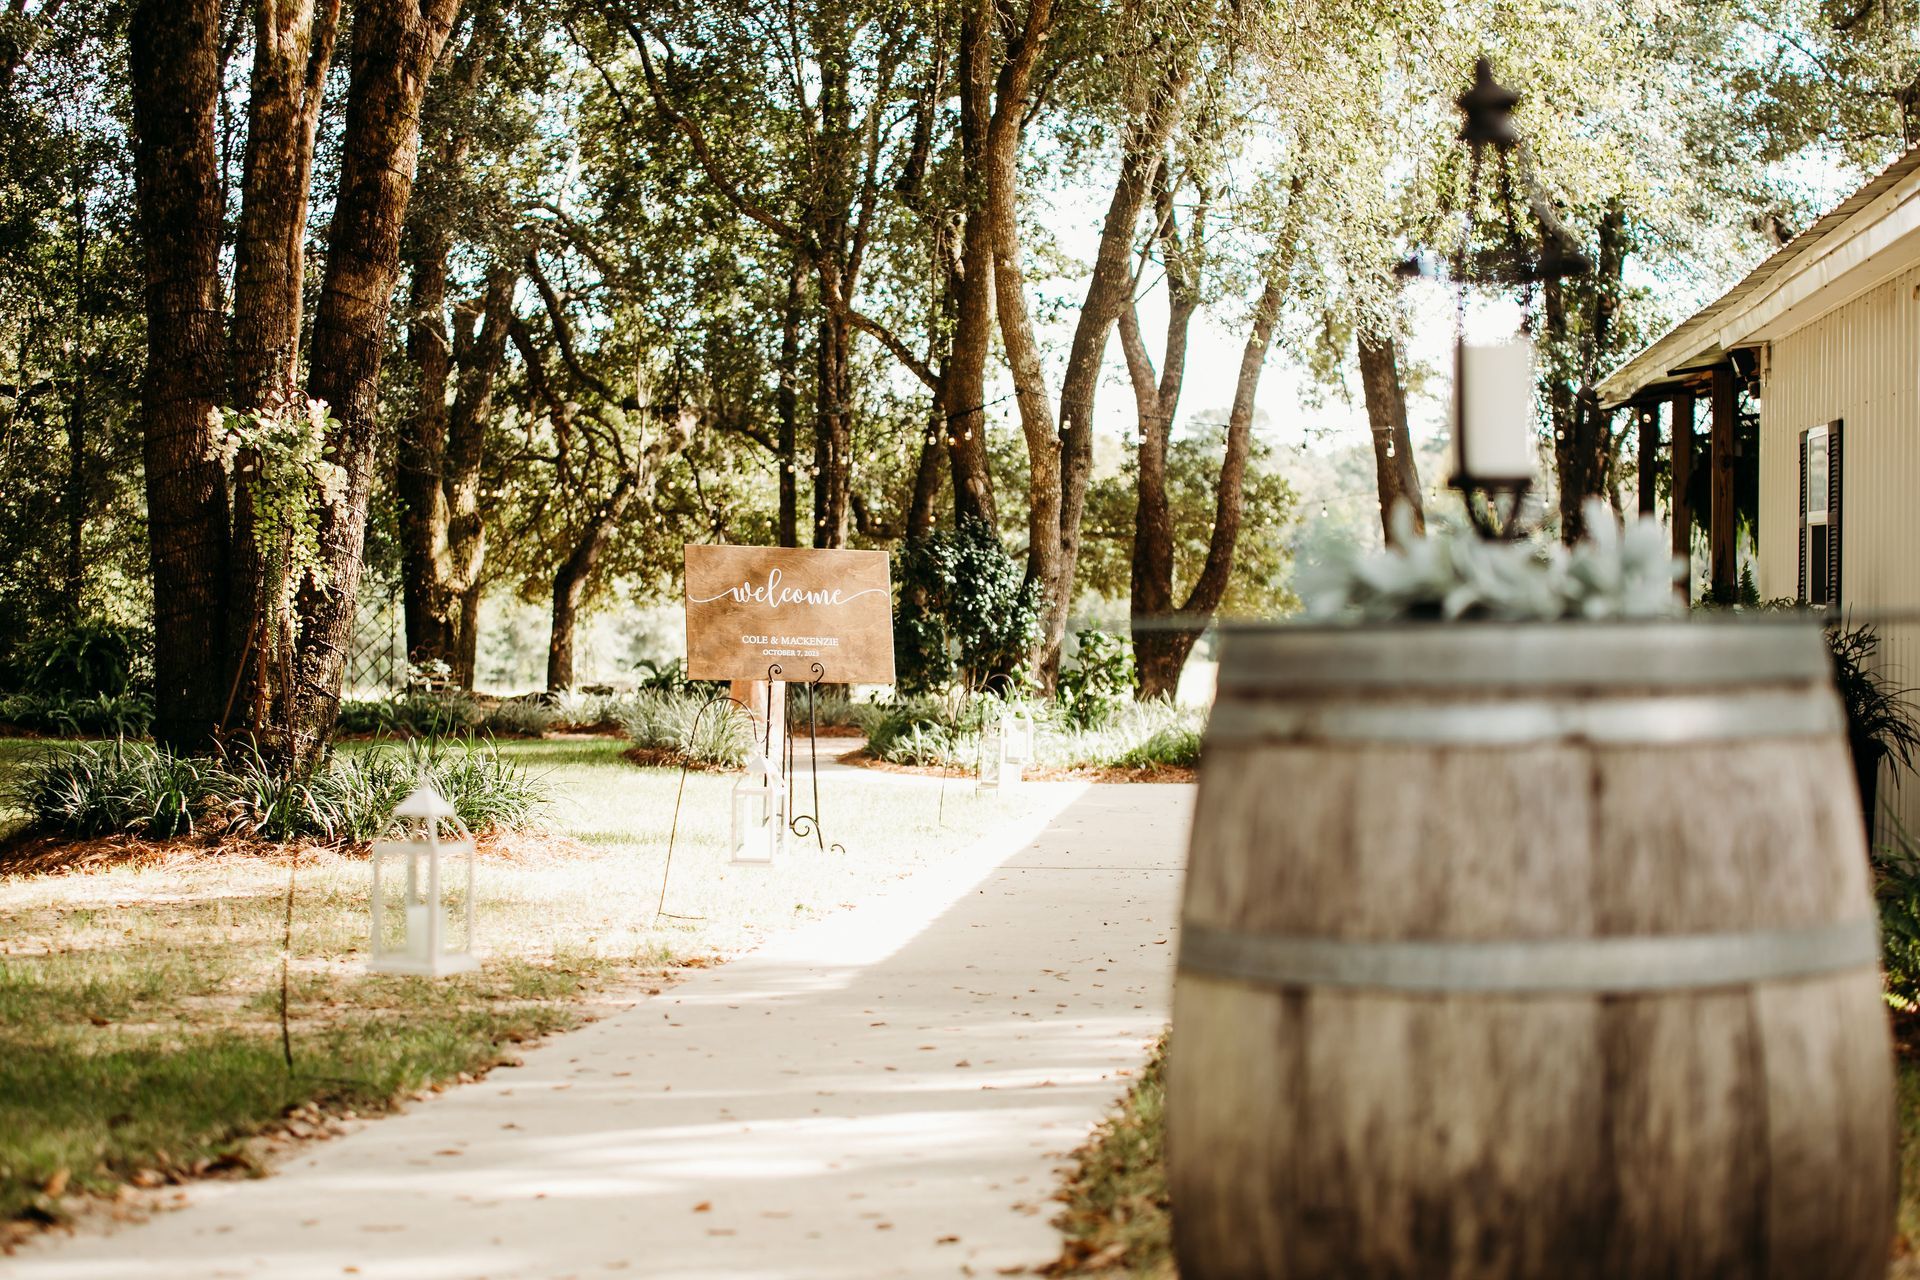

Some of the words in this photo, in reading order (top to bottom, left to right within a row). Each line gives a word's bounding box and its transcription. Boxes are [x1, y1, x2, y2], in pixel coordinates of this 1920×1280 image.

[688, 568, 888, 608] welcome
[742, 635, 769, 645] COLE
[770, 636, 779, 645] &
[781, 636, 839, 646] MACKENZIE
[762, 649, 796, 657] OCTOBER
